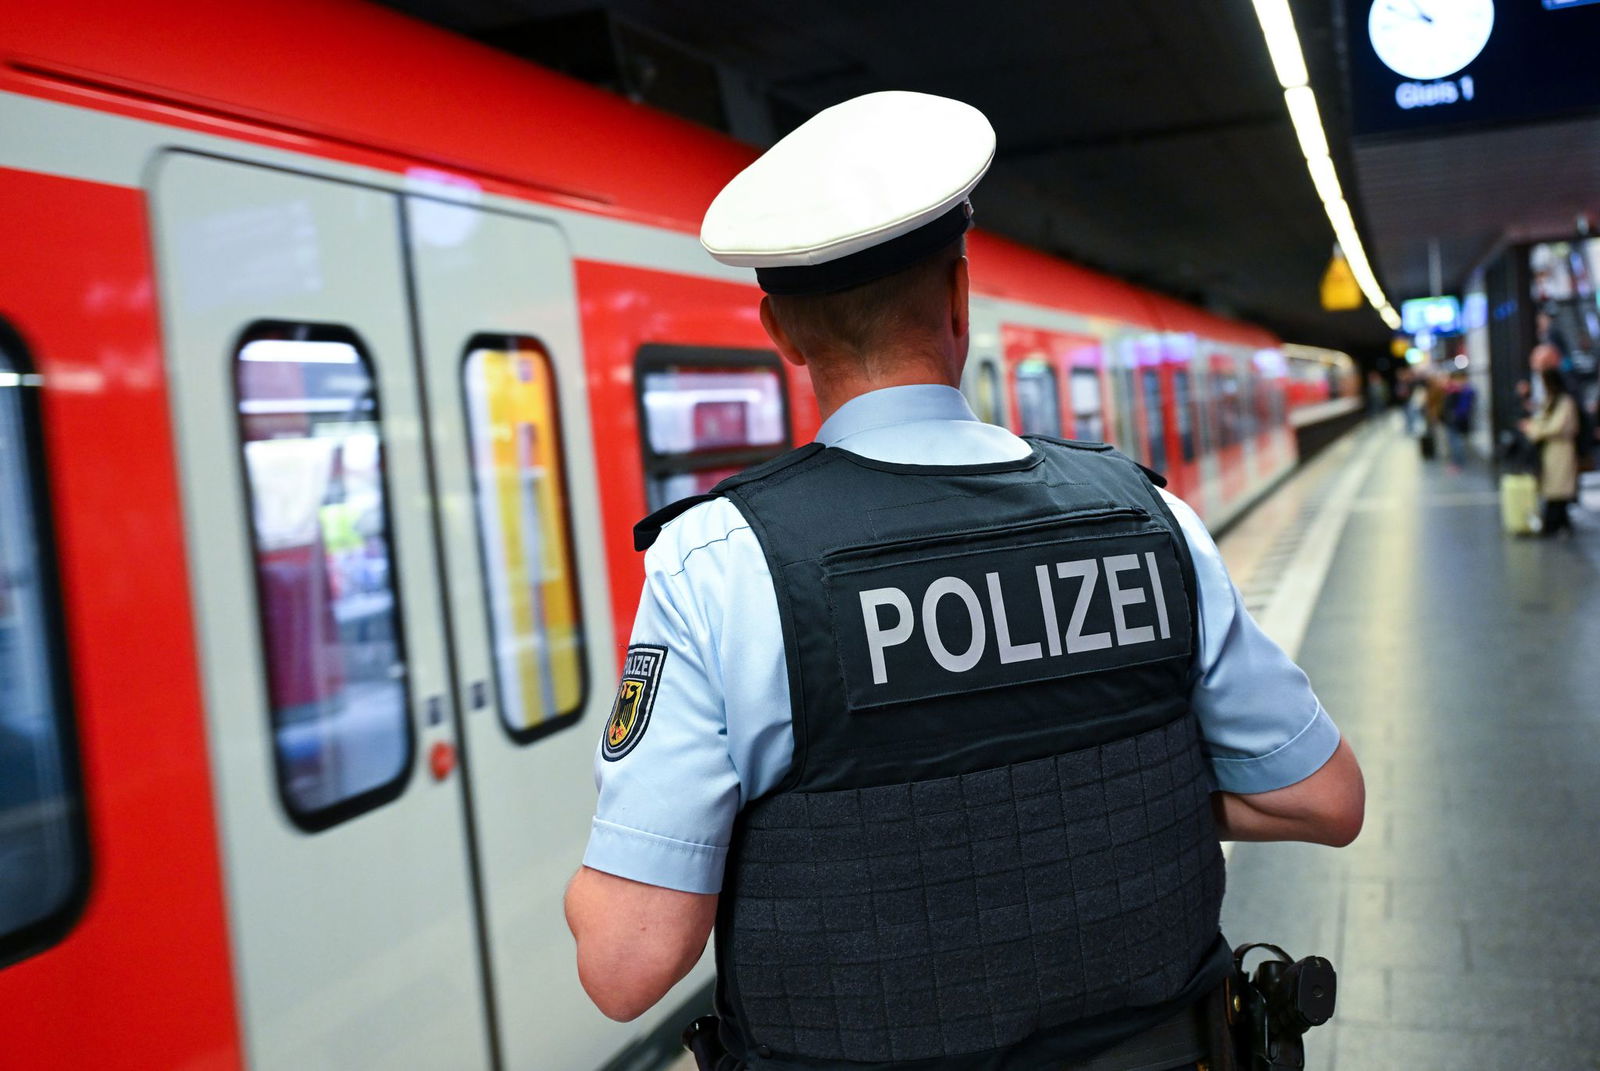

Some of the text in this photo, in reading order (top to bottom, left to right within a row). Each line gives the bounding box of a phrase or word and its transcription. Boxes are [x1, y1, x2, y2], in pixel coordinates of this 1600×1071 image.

[1460, 74, 1475, 101] 1
[859, 551, 1171, 685] POLIZEI
[624, 655, 656, 677] OLIZEI
